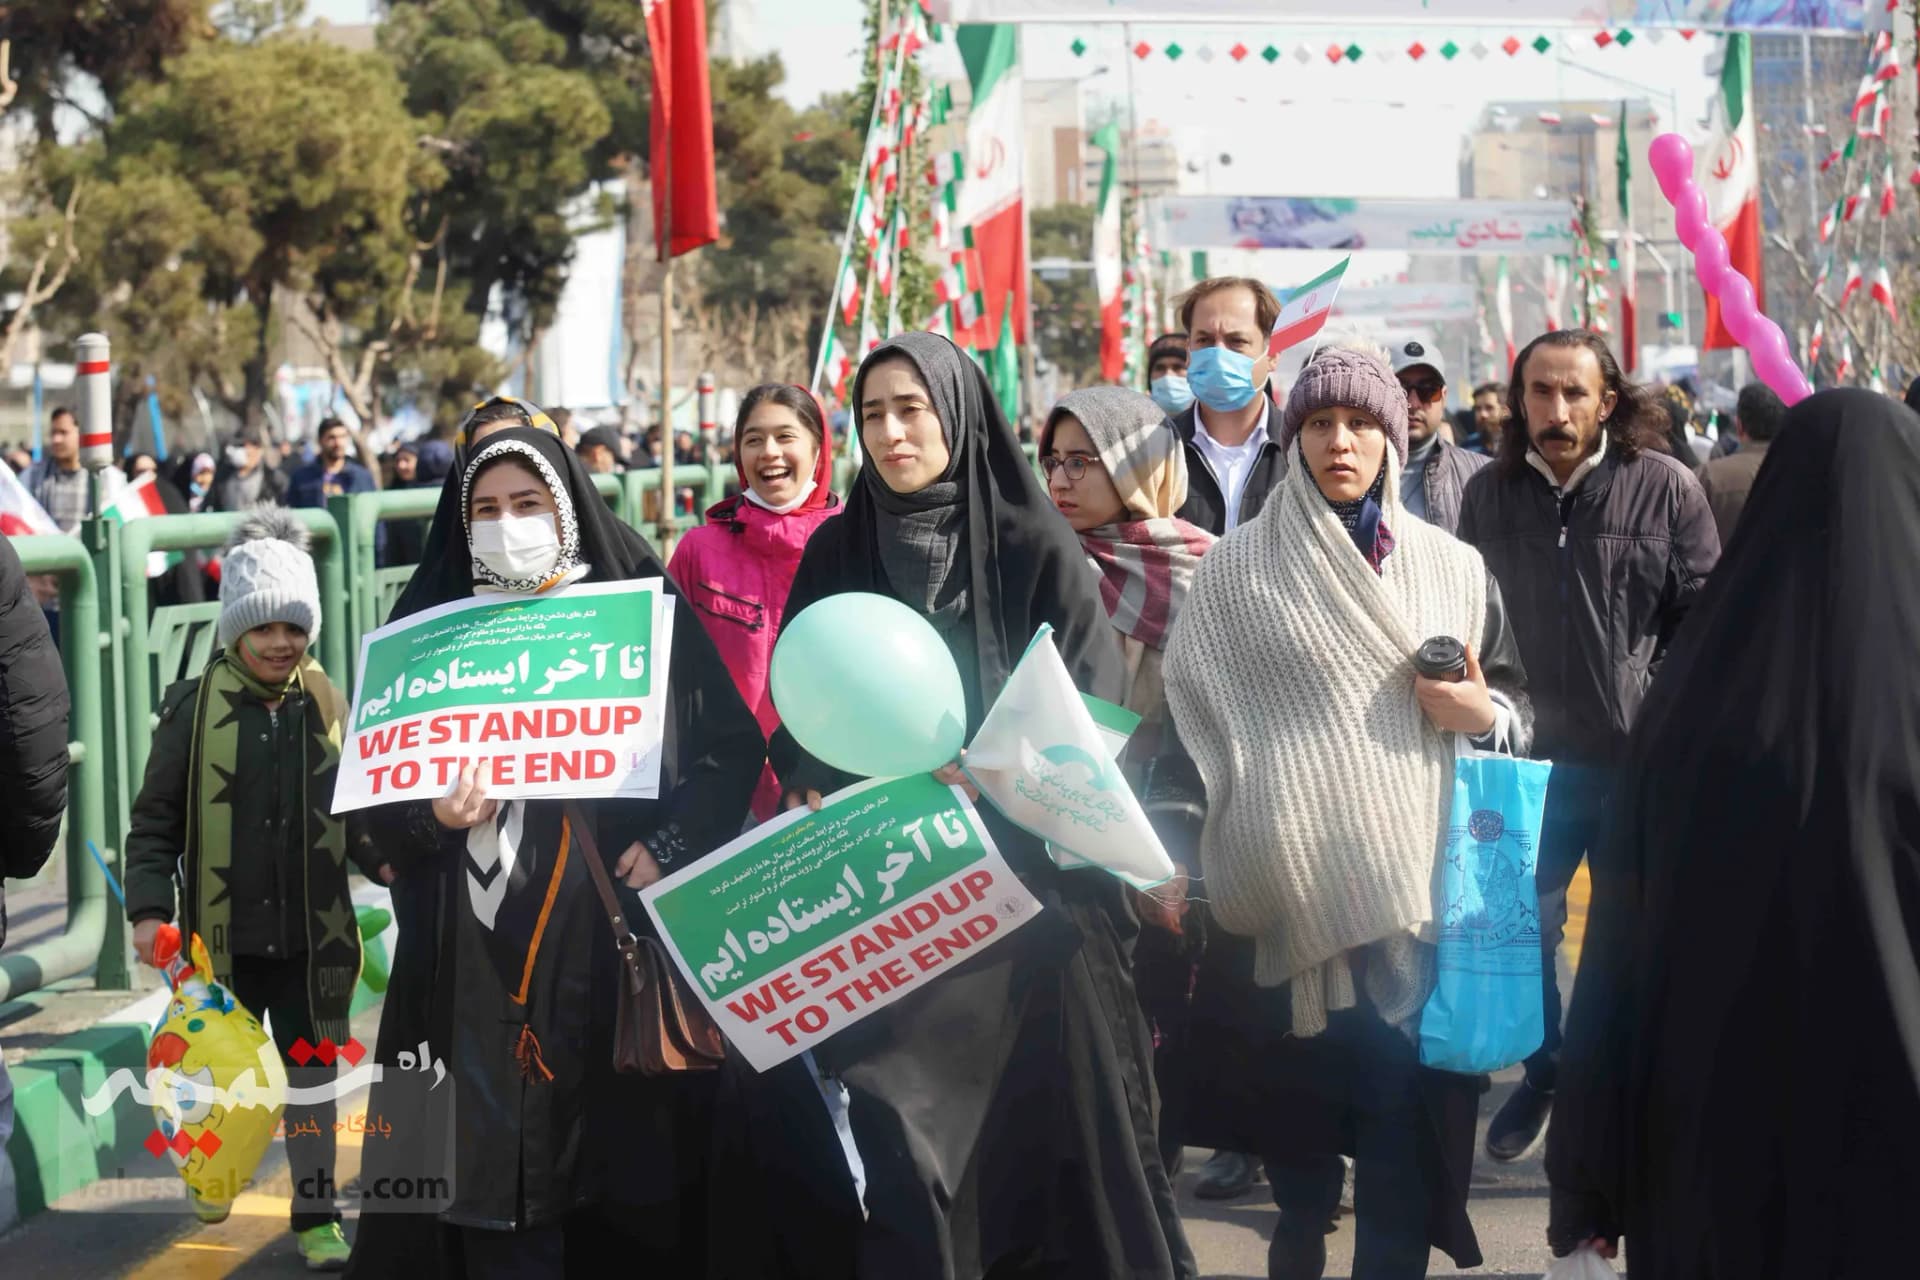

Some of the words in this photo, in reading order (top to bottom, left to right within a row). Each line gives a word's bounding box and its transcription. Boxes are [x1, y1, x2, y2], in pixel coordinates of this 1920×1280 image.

[408, 650, 529, 699] ایستاده
[533, 643, 615, 694] آخر
[619, 644, 646, 679] تا
[359, 673, 405, 724] ایم
[359, 720, 422, 760] WE
[428, 706, 642, 744] STANDUP
[366, 761, 421, 795] TO
[524, 749, 616, 783] END
[933, 807, 968, 848] تا
[877, 817, 932, 904] آخر
[747, 864, 865, 954] ایستاده
[700, 928, 747, 994] ایم
[726, 972, 805, 1024] WE
[800, 869, 994, 988] STANDUP
[765, 1005, 830, 1047] TO
[825, 958, 915, 1013] THE
[909, 914, 998, 972] END
